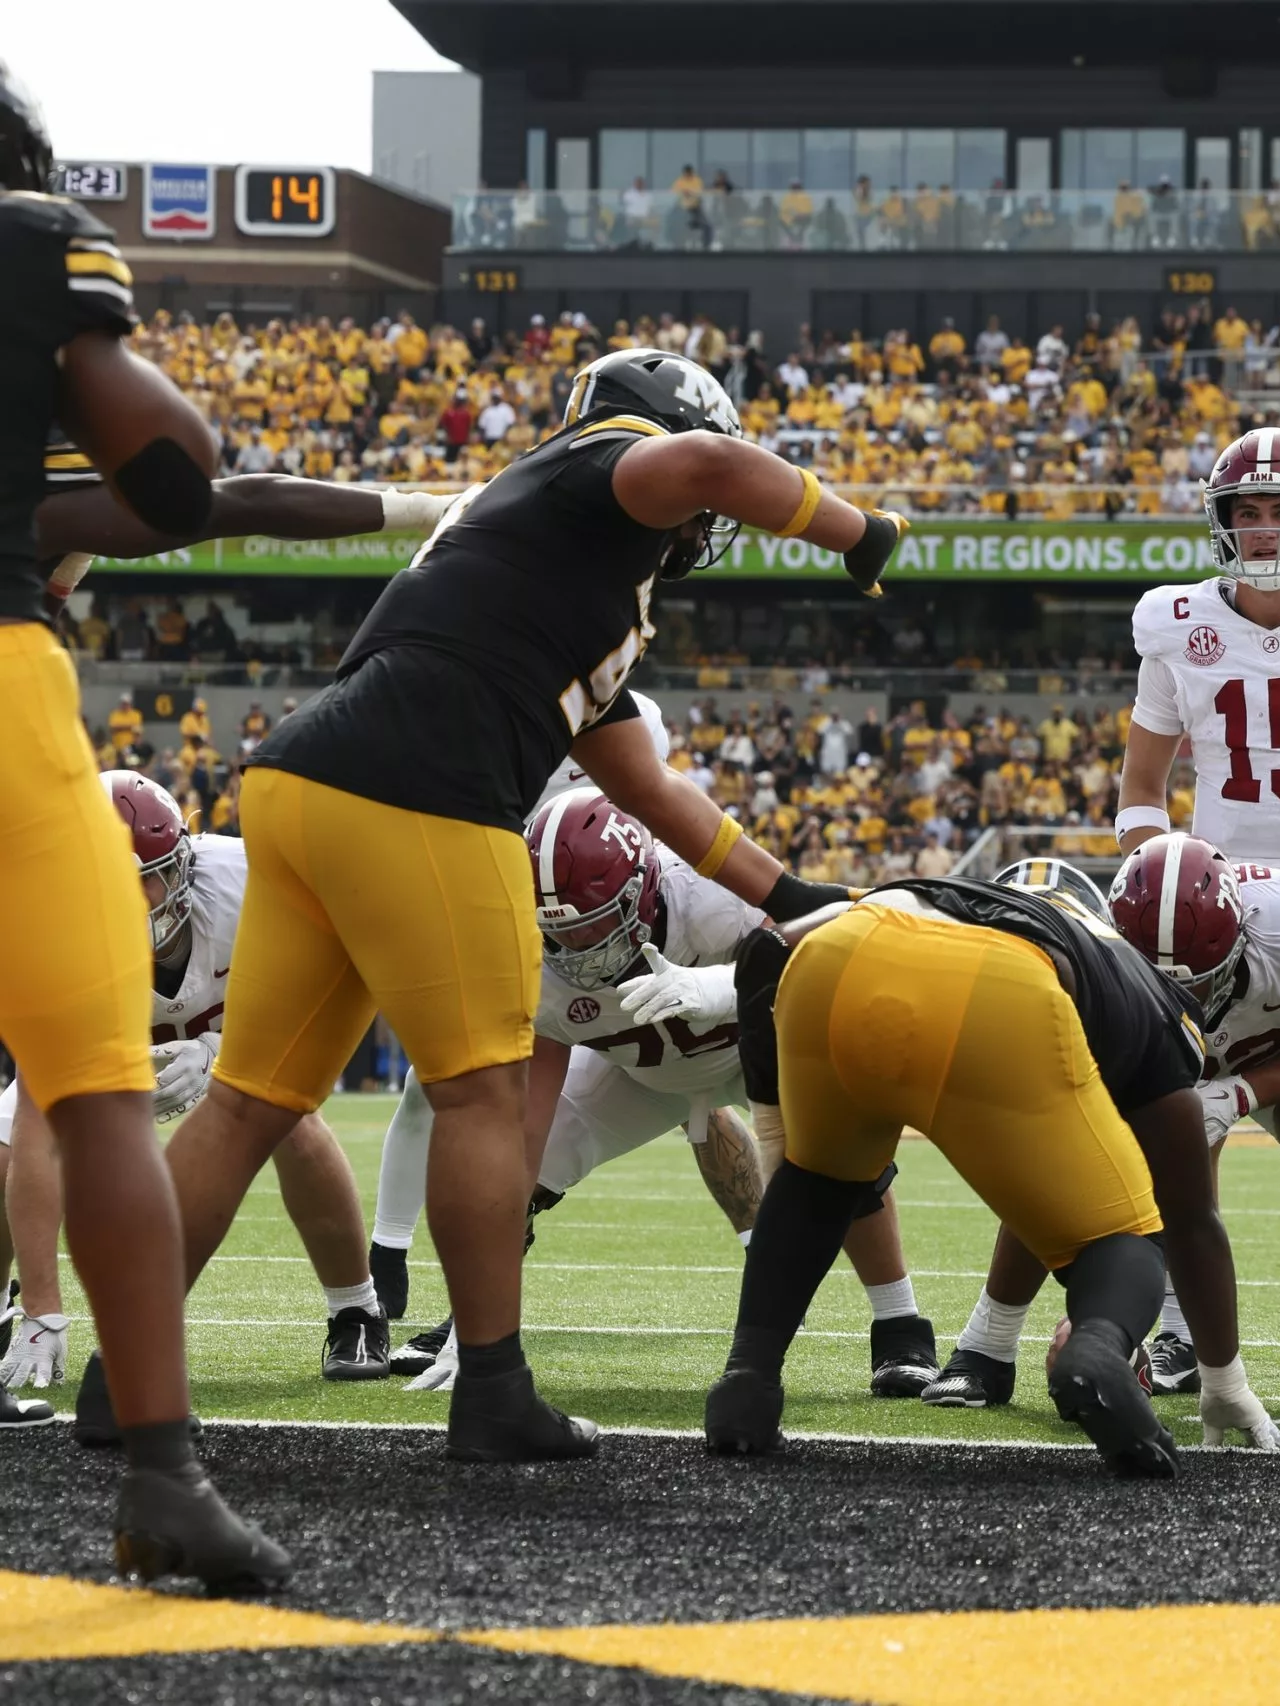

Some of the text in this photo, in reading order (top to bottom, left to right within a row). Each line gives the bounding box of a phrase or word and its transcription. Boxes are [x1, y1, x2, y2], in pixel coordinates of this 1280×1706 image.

[271, 176, 319, 221] 14
[475, 271, 517, 291] 131
[1169, 272, 1213, 293] 130
[1250, 473, 1273, 482] BAMA
[705, 535, 749, 569] ET
[758, 535, 848, 571] YOU
[896, 536, 945, 569] AT
[1173, 597, 1190, 620] C
[1189, 627, 1218, 656] SEC
[1188, 651, 1222, 665] GRADUATE
[600, 812, 641, 862] 75
[542, 908, 566, 919] BAMA
[569, 1001, 597, 1022] SEC
